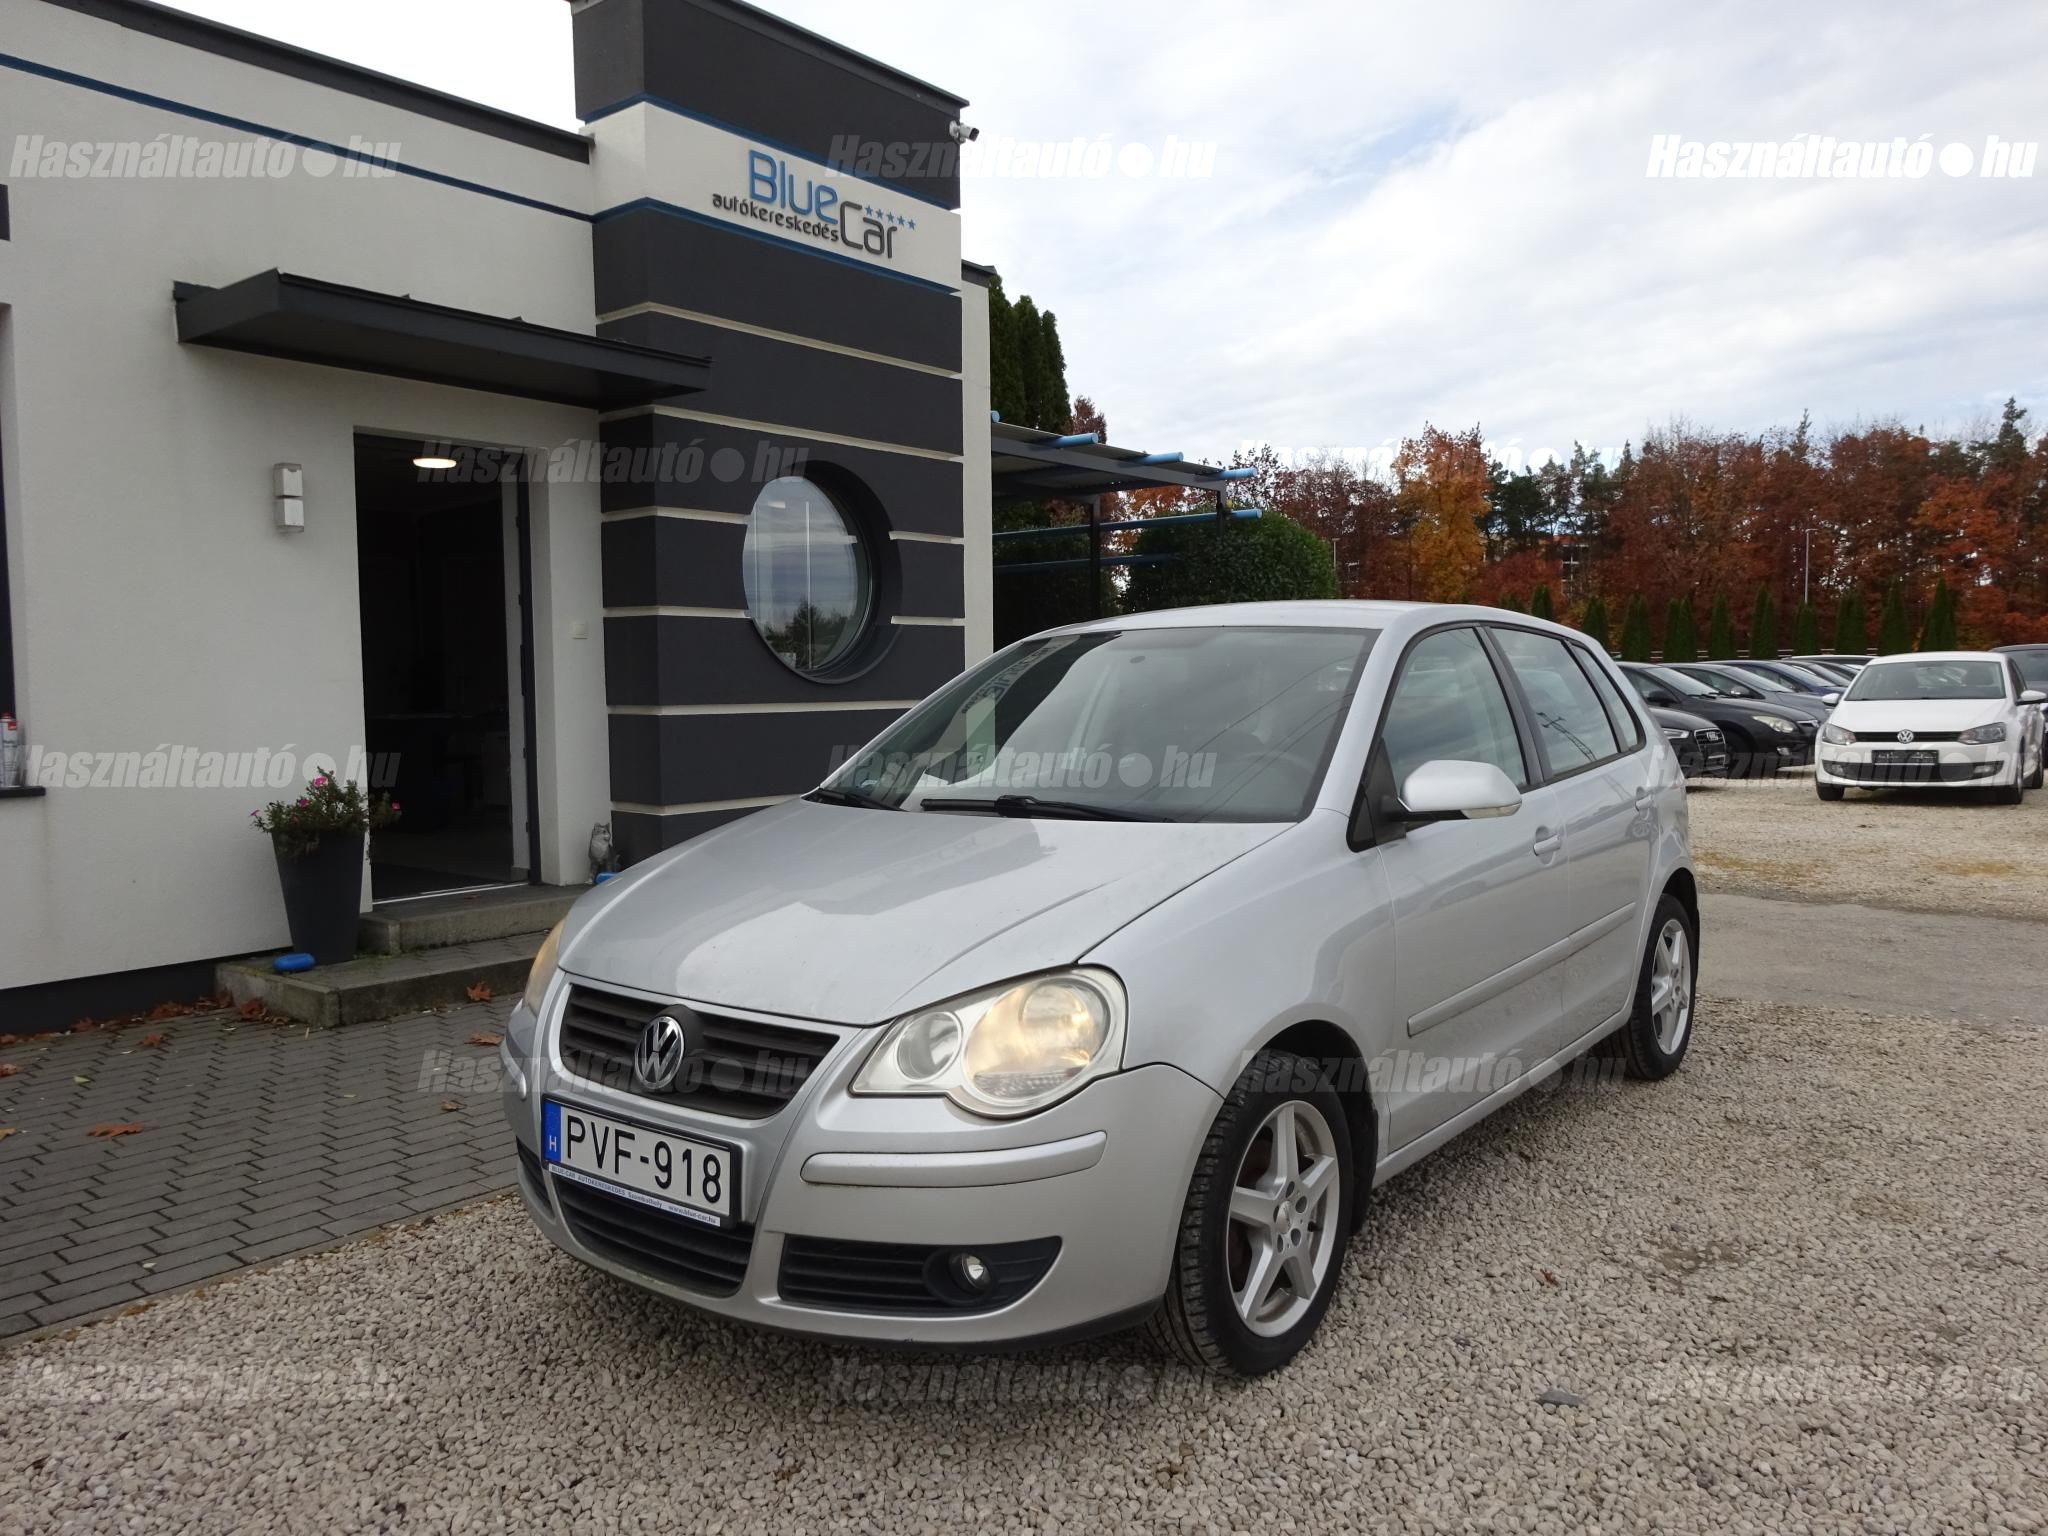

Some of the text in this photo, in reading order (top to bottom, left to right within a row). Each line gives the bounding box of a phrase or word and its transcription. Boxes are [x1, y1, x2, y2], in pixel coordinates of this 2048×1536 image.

[711, 192, 840, 242] autókereskedés
[548, 1114, 722, 1204] H PVF-918
